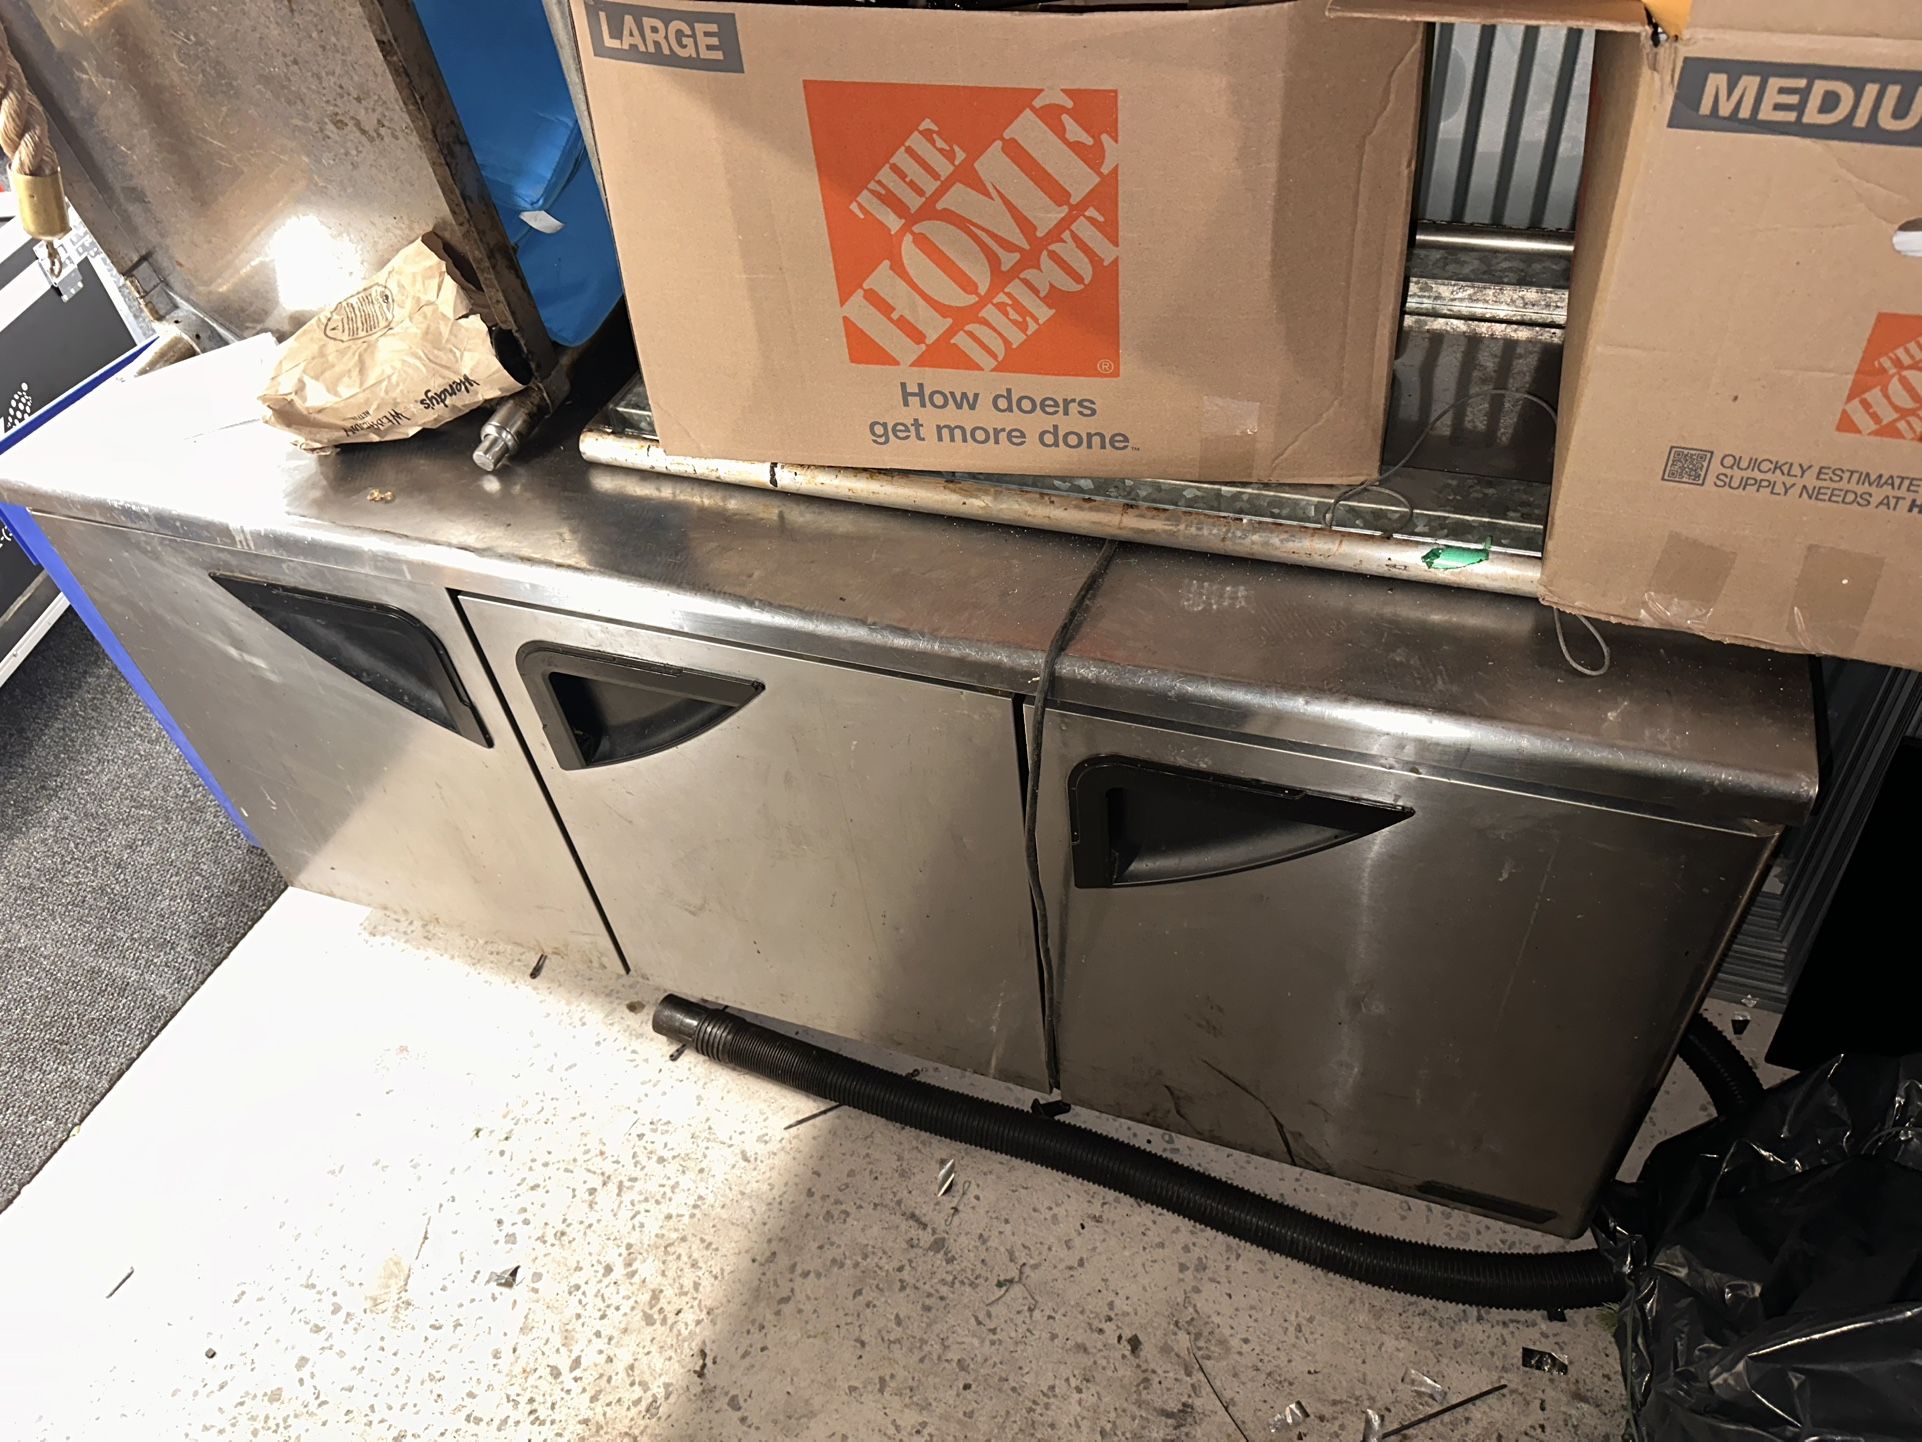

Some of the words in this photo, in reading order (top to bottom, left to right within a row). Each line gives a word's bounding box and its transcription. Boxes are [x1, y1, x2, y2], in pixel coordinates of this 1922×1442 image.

[598, 10, 725, 61] LARGE
[1698, 71, 1922, 132] MEDIU
[848, 117, 967, 235] THE
[840, 88, 1119, 367] HOME
[950, 207, 1119, 372] DEPOT
[420, 373, 480, 410] Wendy's
[899, 381, 980, 411] How
[991, 387, 1098, 418] doers
[868, 417, 926, 446] get
[935, 423, 1027, 447] more
[1713, 472, 1796, 497] SUPPLY
[1798, 484, 1873, 508] NEEDS
[1875, 494, 1906, 512] AT
[1719, 453, 1813, 479] QUICKLY
[1815, 465, 1922, 495] ESTIMATE
